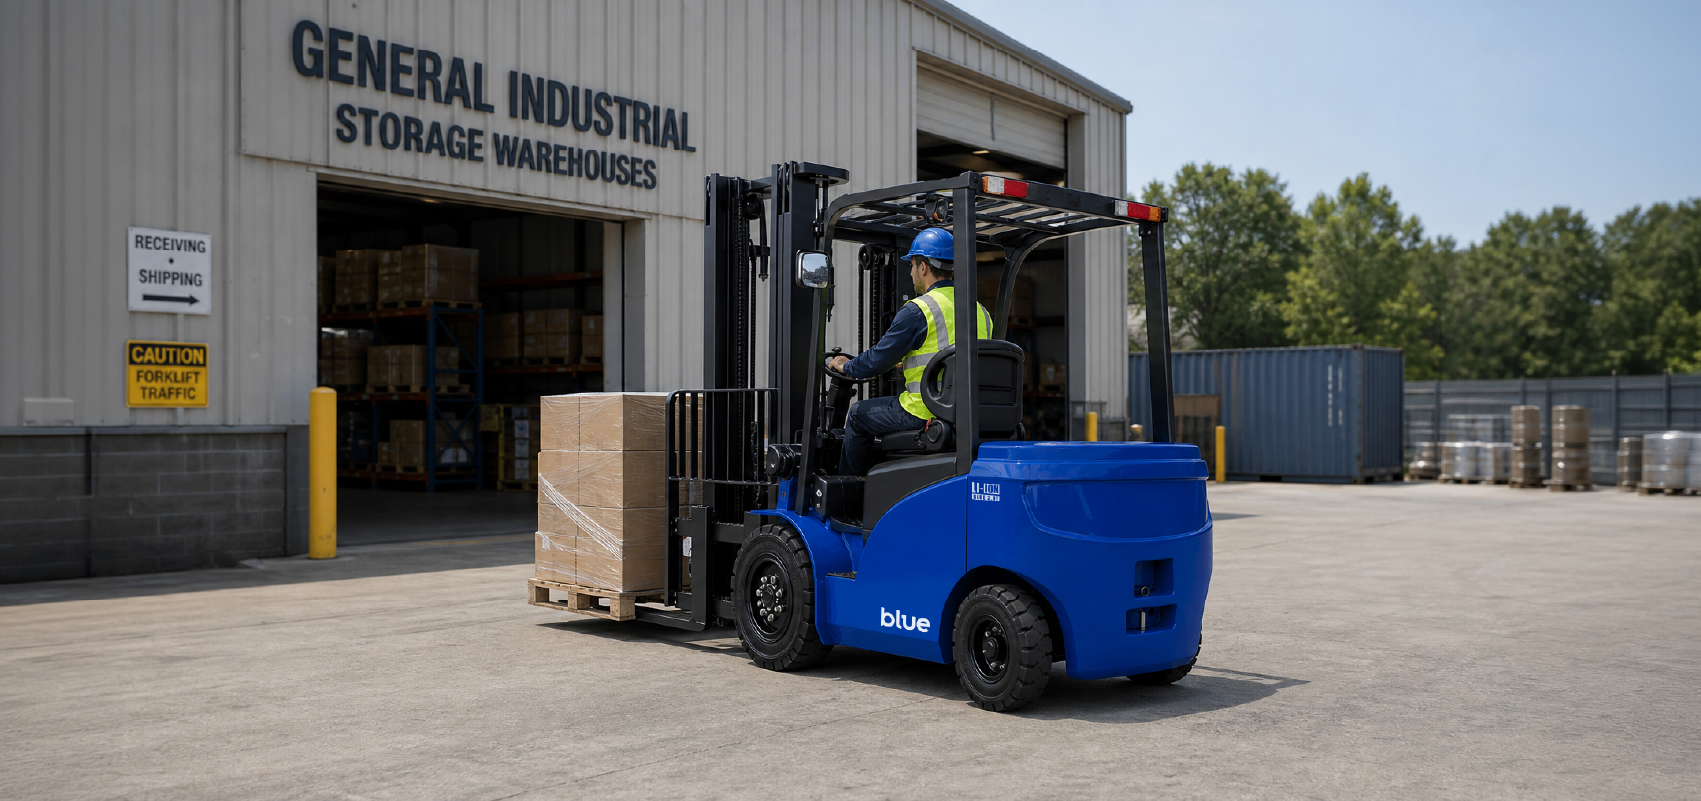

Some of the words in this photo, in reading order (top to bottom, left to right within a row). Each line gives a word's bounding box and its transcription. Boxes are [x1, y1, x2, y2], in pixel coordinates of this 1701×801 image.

[290, 19, 495, 114] GENERAL
[508, 69, 697, 153] INDUSTRIAL
[336, 103, 485, 163] STORAGE
[493, 132, 657, 190] WAREHOUSES
[134, 234, 206, 254] RECEIVING
[138, 268, 203, 287] SHIPPING
[131, 345, 205, 365] CAUTION
[136, 370, 201, 384] FORKLIFT
[140, 386, 197, 400] TRAFFIC
[971, 481, 1000, 495] LI-ION
[880, 606, 931, 633] blue
